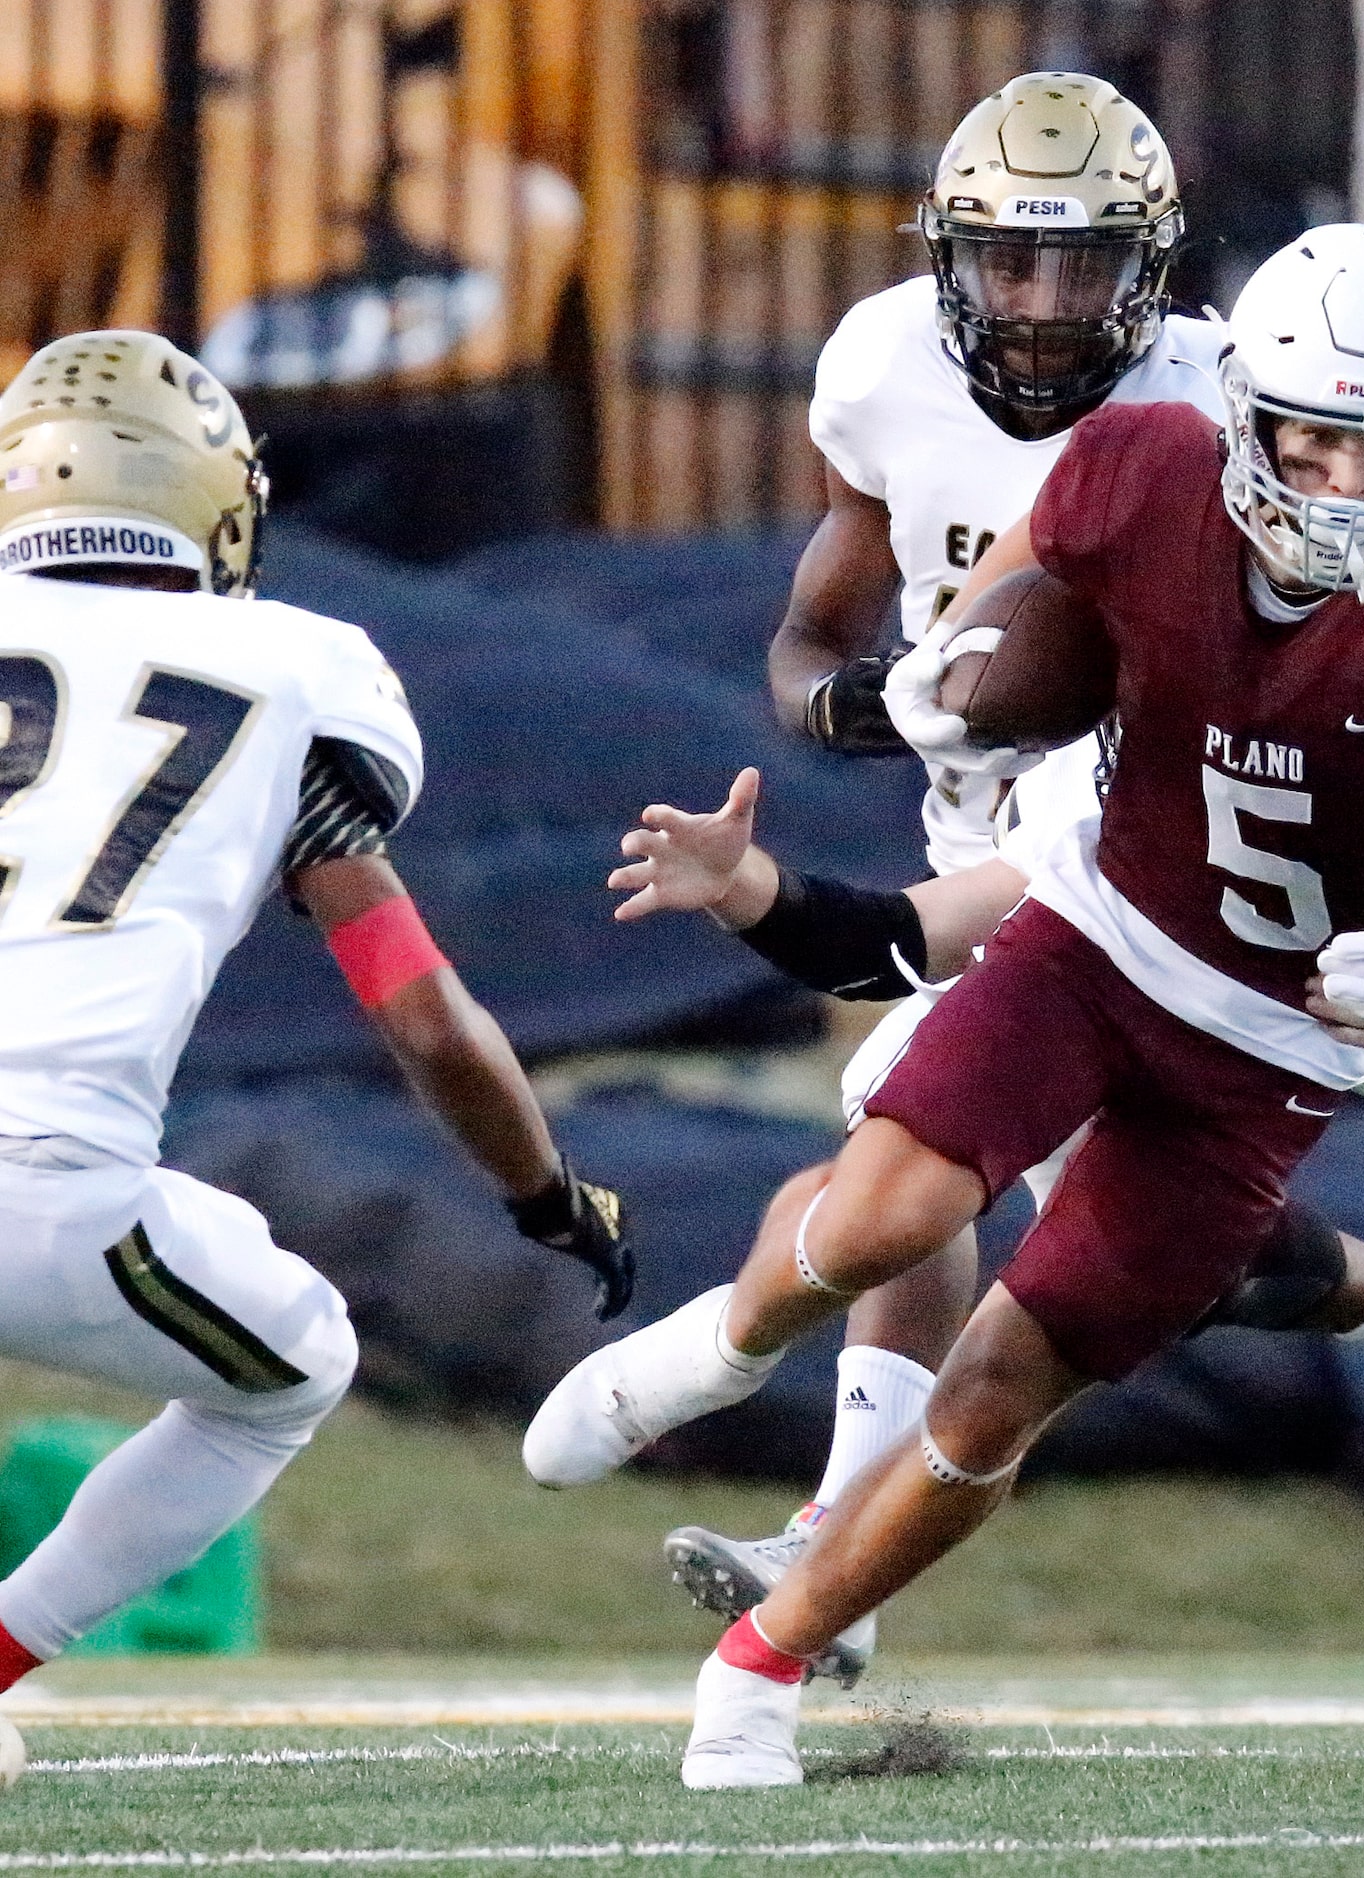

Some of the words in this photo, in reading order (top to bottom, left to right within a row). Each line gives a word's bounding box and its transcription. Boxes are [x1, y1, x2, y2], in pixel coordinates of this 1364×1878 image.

[1015, 199, 1067, 216] PESH
[0, 526, 175, 570] BROTHERHOOD
[1205, 723, 1304, 784] PLANO
[1201, 762, 1333, 952] 5
